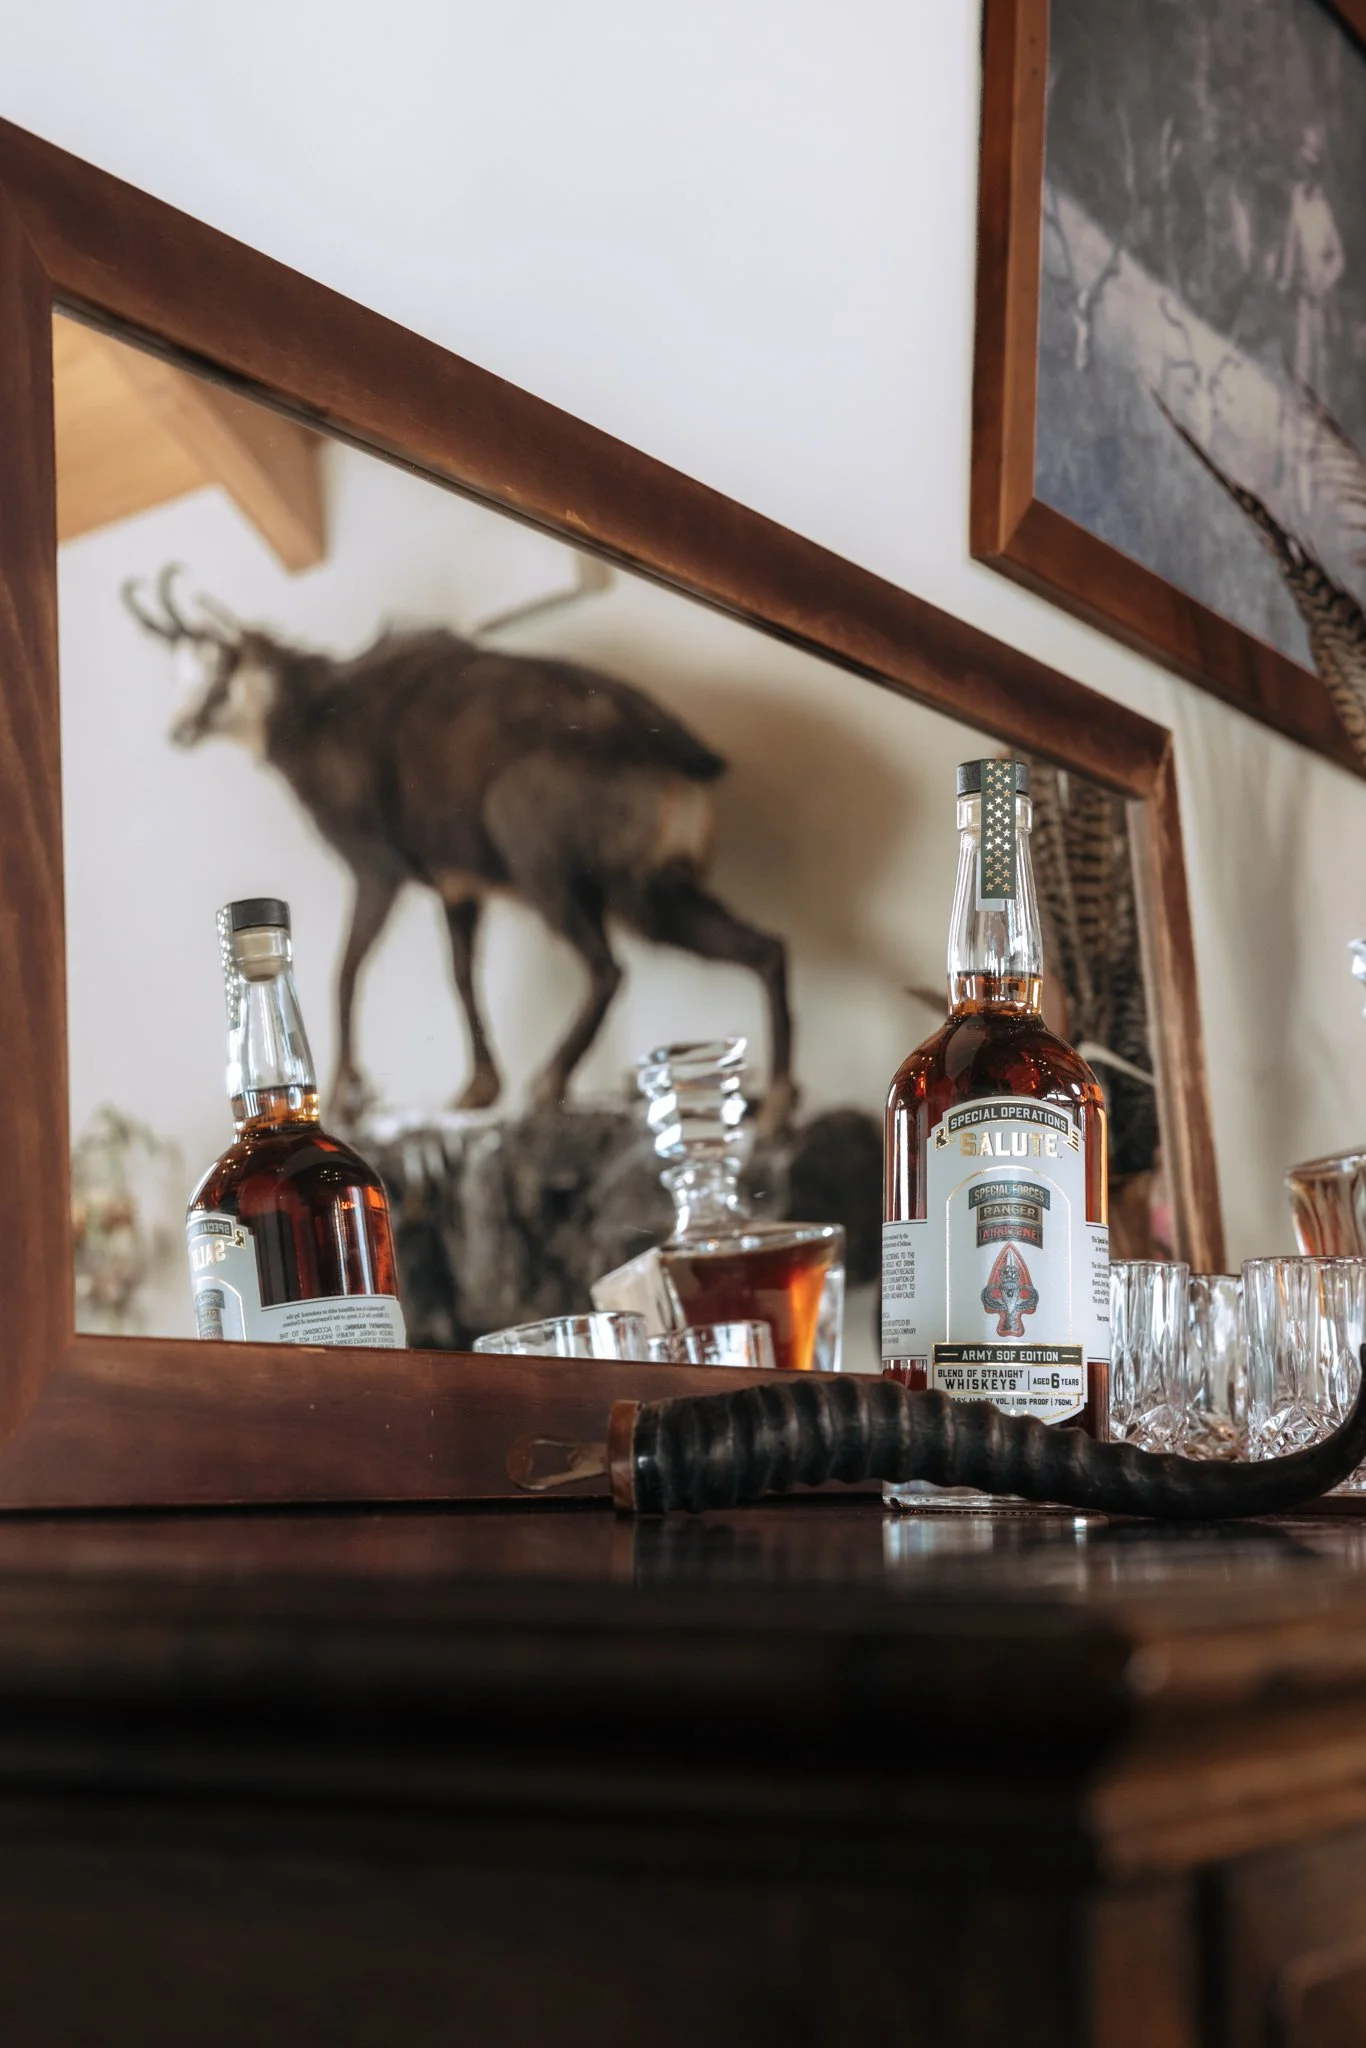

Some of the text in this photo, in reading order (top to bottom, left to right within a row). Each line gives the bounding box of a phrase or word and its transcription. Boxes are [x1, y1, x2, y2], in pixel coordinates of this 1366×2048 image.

[950, 1106, 1067, 1131] SPECIAL OPERATIONS
[974, 1184, 1045, 1201] SPECIAL FORCES
[983, 1204, 1037, 1217] RANGER
[980, 1226, 1038, 1240] AIRBORNE
[961, 1350, 1059, 1362] ARMY SOF EDITION
[937, 1369, 1024, 1378] BLEND OF STRAIGHT
[945, 1378, 1017, 1390] WHISKEYS
[1032, 1373, 1079, 1389] AGED 6 YEARS
[1054, 1398, 1073, 1406] 750ML
